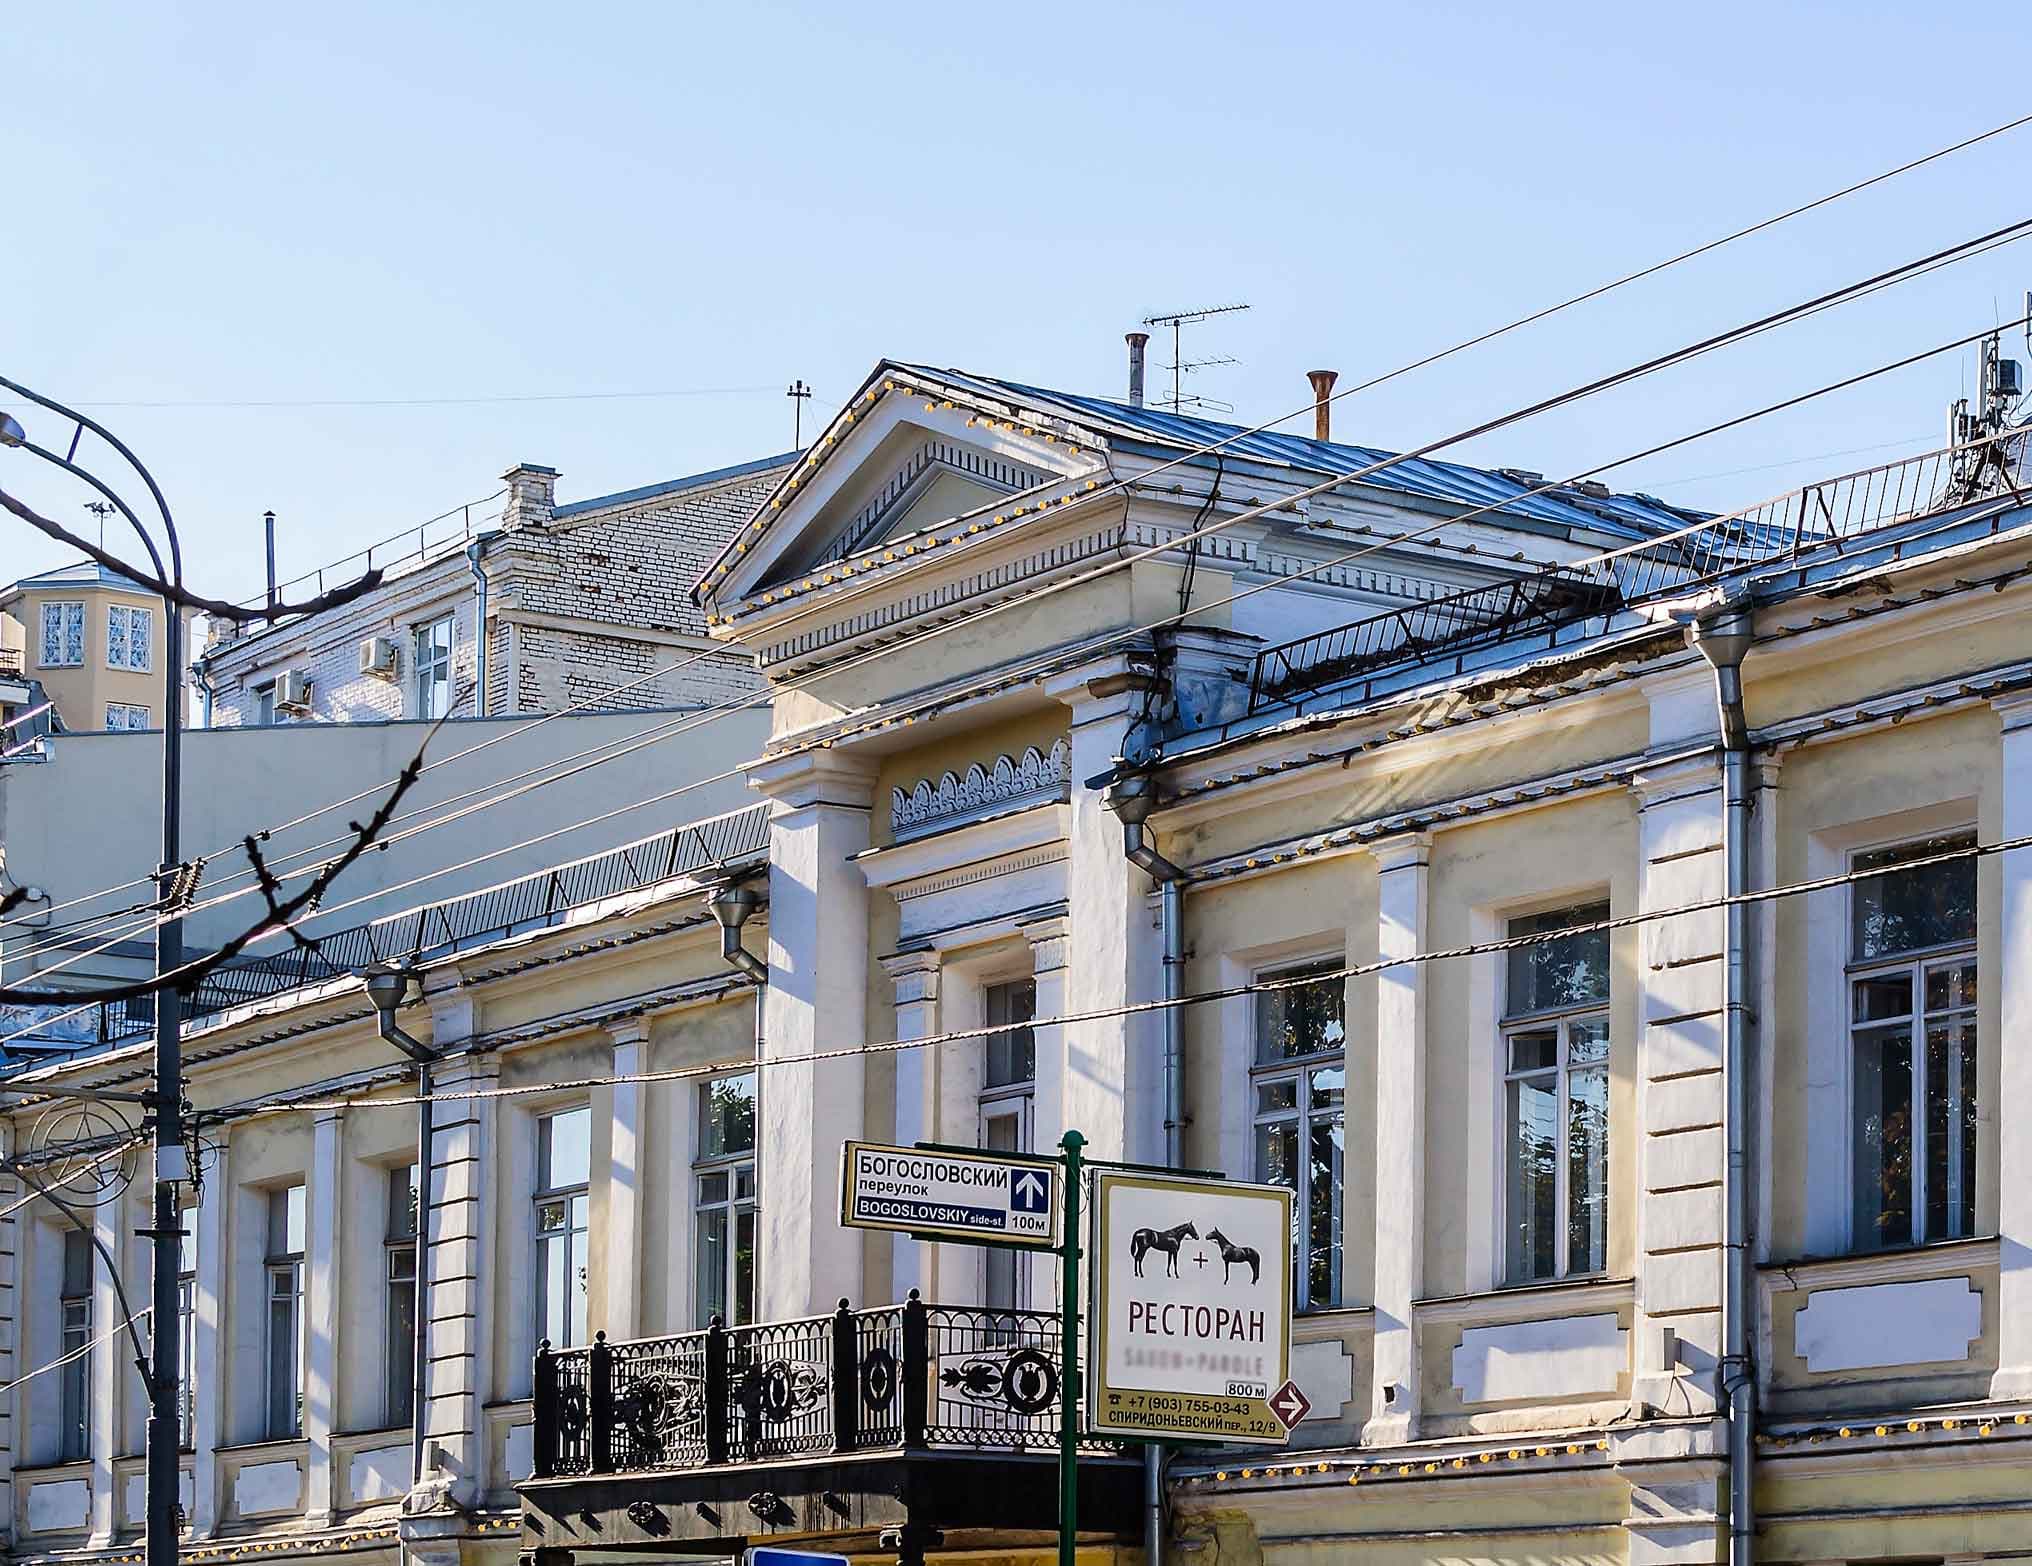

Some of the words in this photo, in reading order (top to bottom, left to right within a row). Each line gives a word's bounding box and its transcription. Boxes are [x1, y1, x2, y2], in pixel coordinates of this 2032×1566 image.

[860, 1155, 1008, 1188] БОГОСЛОВСКИЙ
[859, 1179, 929, 1196] переулок
[860, 1200, 969, 1223] BOGOSLOVSKIY
[1012, 1215, 1045, 1231] 100м
[1128, 1301, 1265, 1343] РЕСТОРАН
[1228, 1383, 1253, 1397] 800
[1128, 1397, 1144, 1409] +7
[1148, 1397, 1182, 1413] (903)
[1186, 1400, 1250, 1415] 755-03-43
[1108, 1410, 1223, 1430] СПИРИДОНЬЕВСКИЙ
[1249, 1420, 1276, 1434] 12/9
